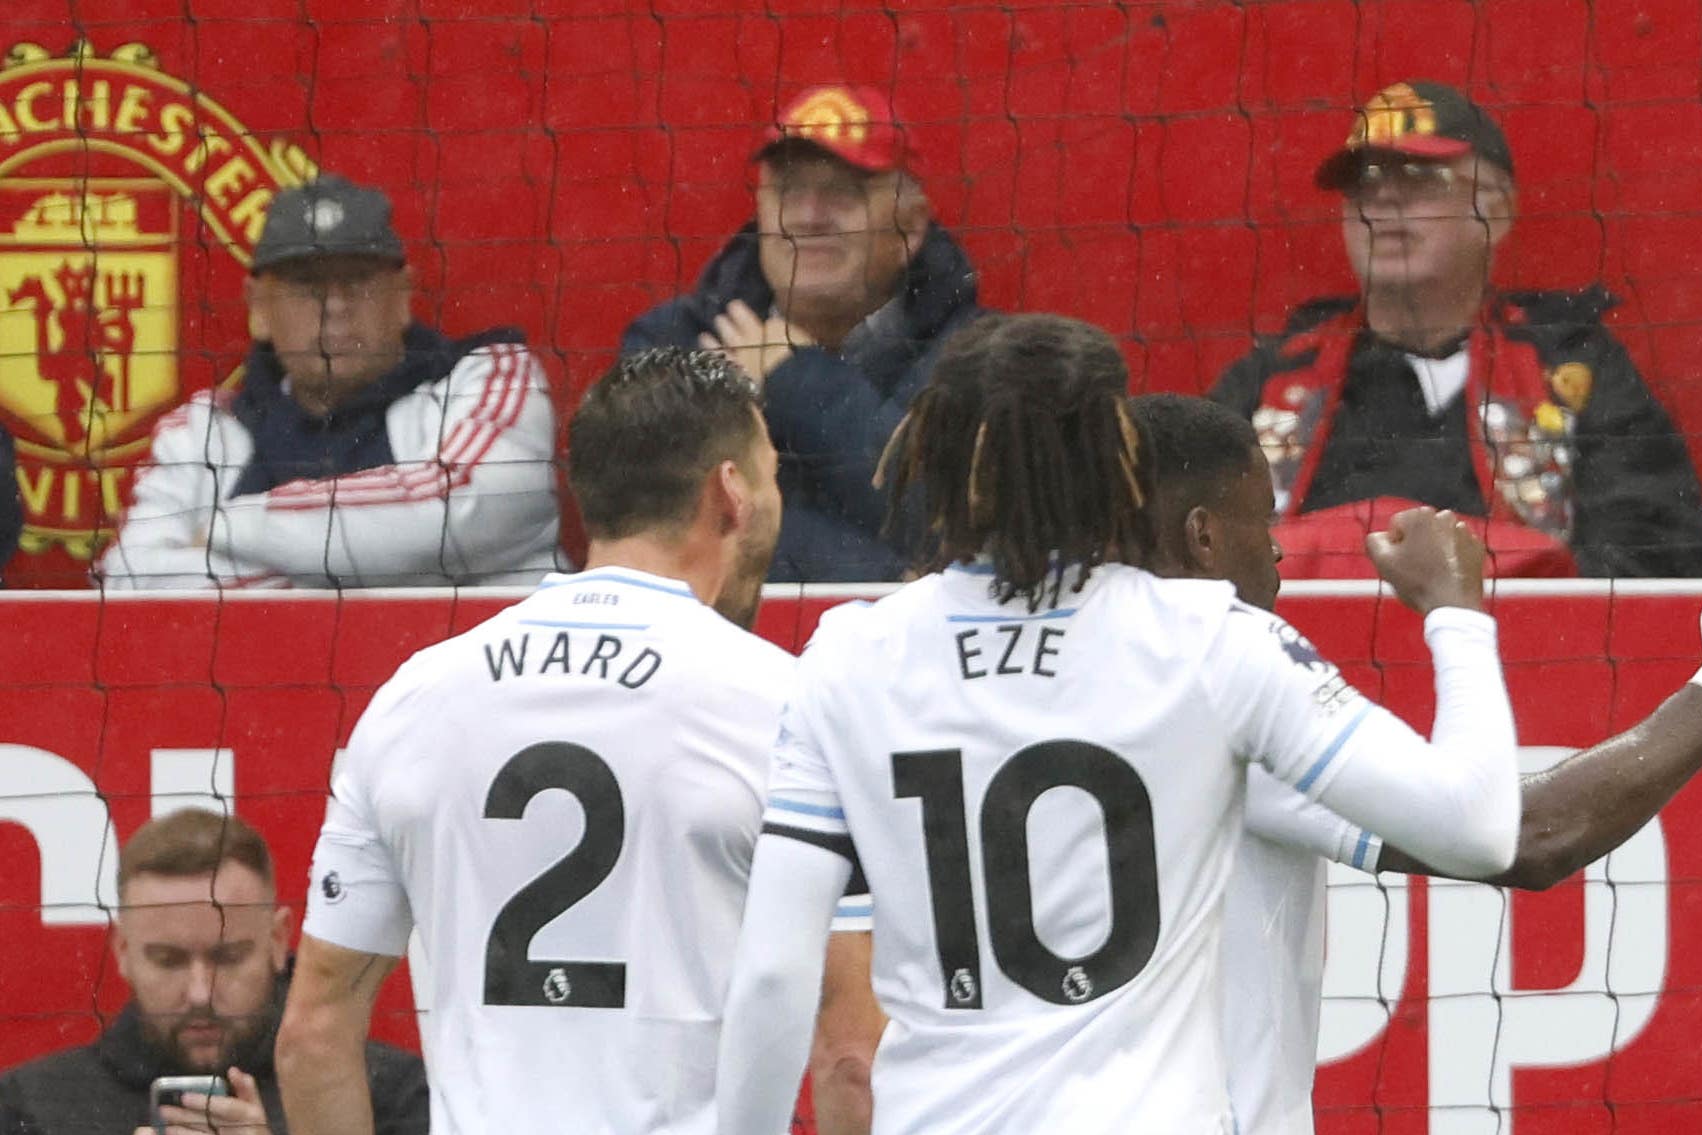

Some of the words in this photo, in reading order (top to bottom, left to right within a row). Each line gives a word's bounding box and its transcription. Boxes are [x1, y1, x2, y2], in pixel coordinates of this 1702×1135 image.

[484, 631, 663, 690] WARD
[955, 624, 1066, 680] EZE
[483, 741, 627, 1009] 2
[890, 739, 1161, 1010] 10
